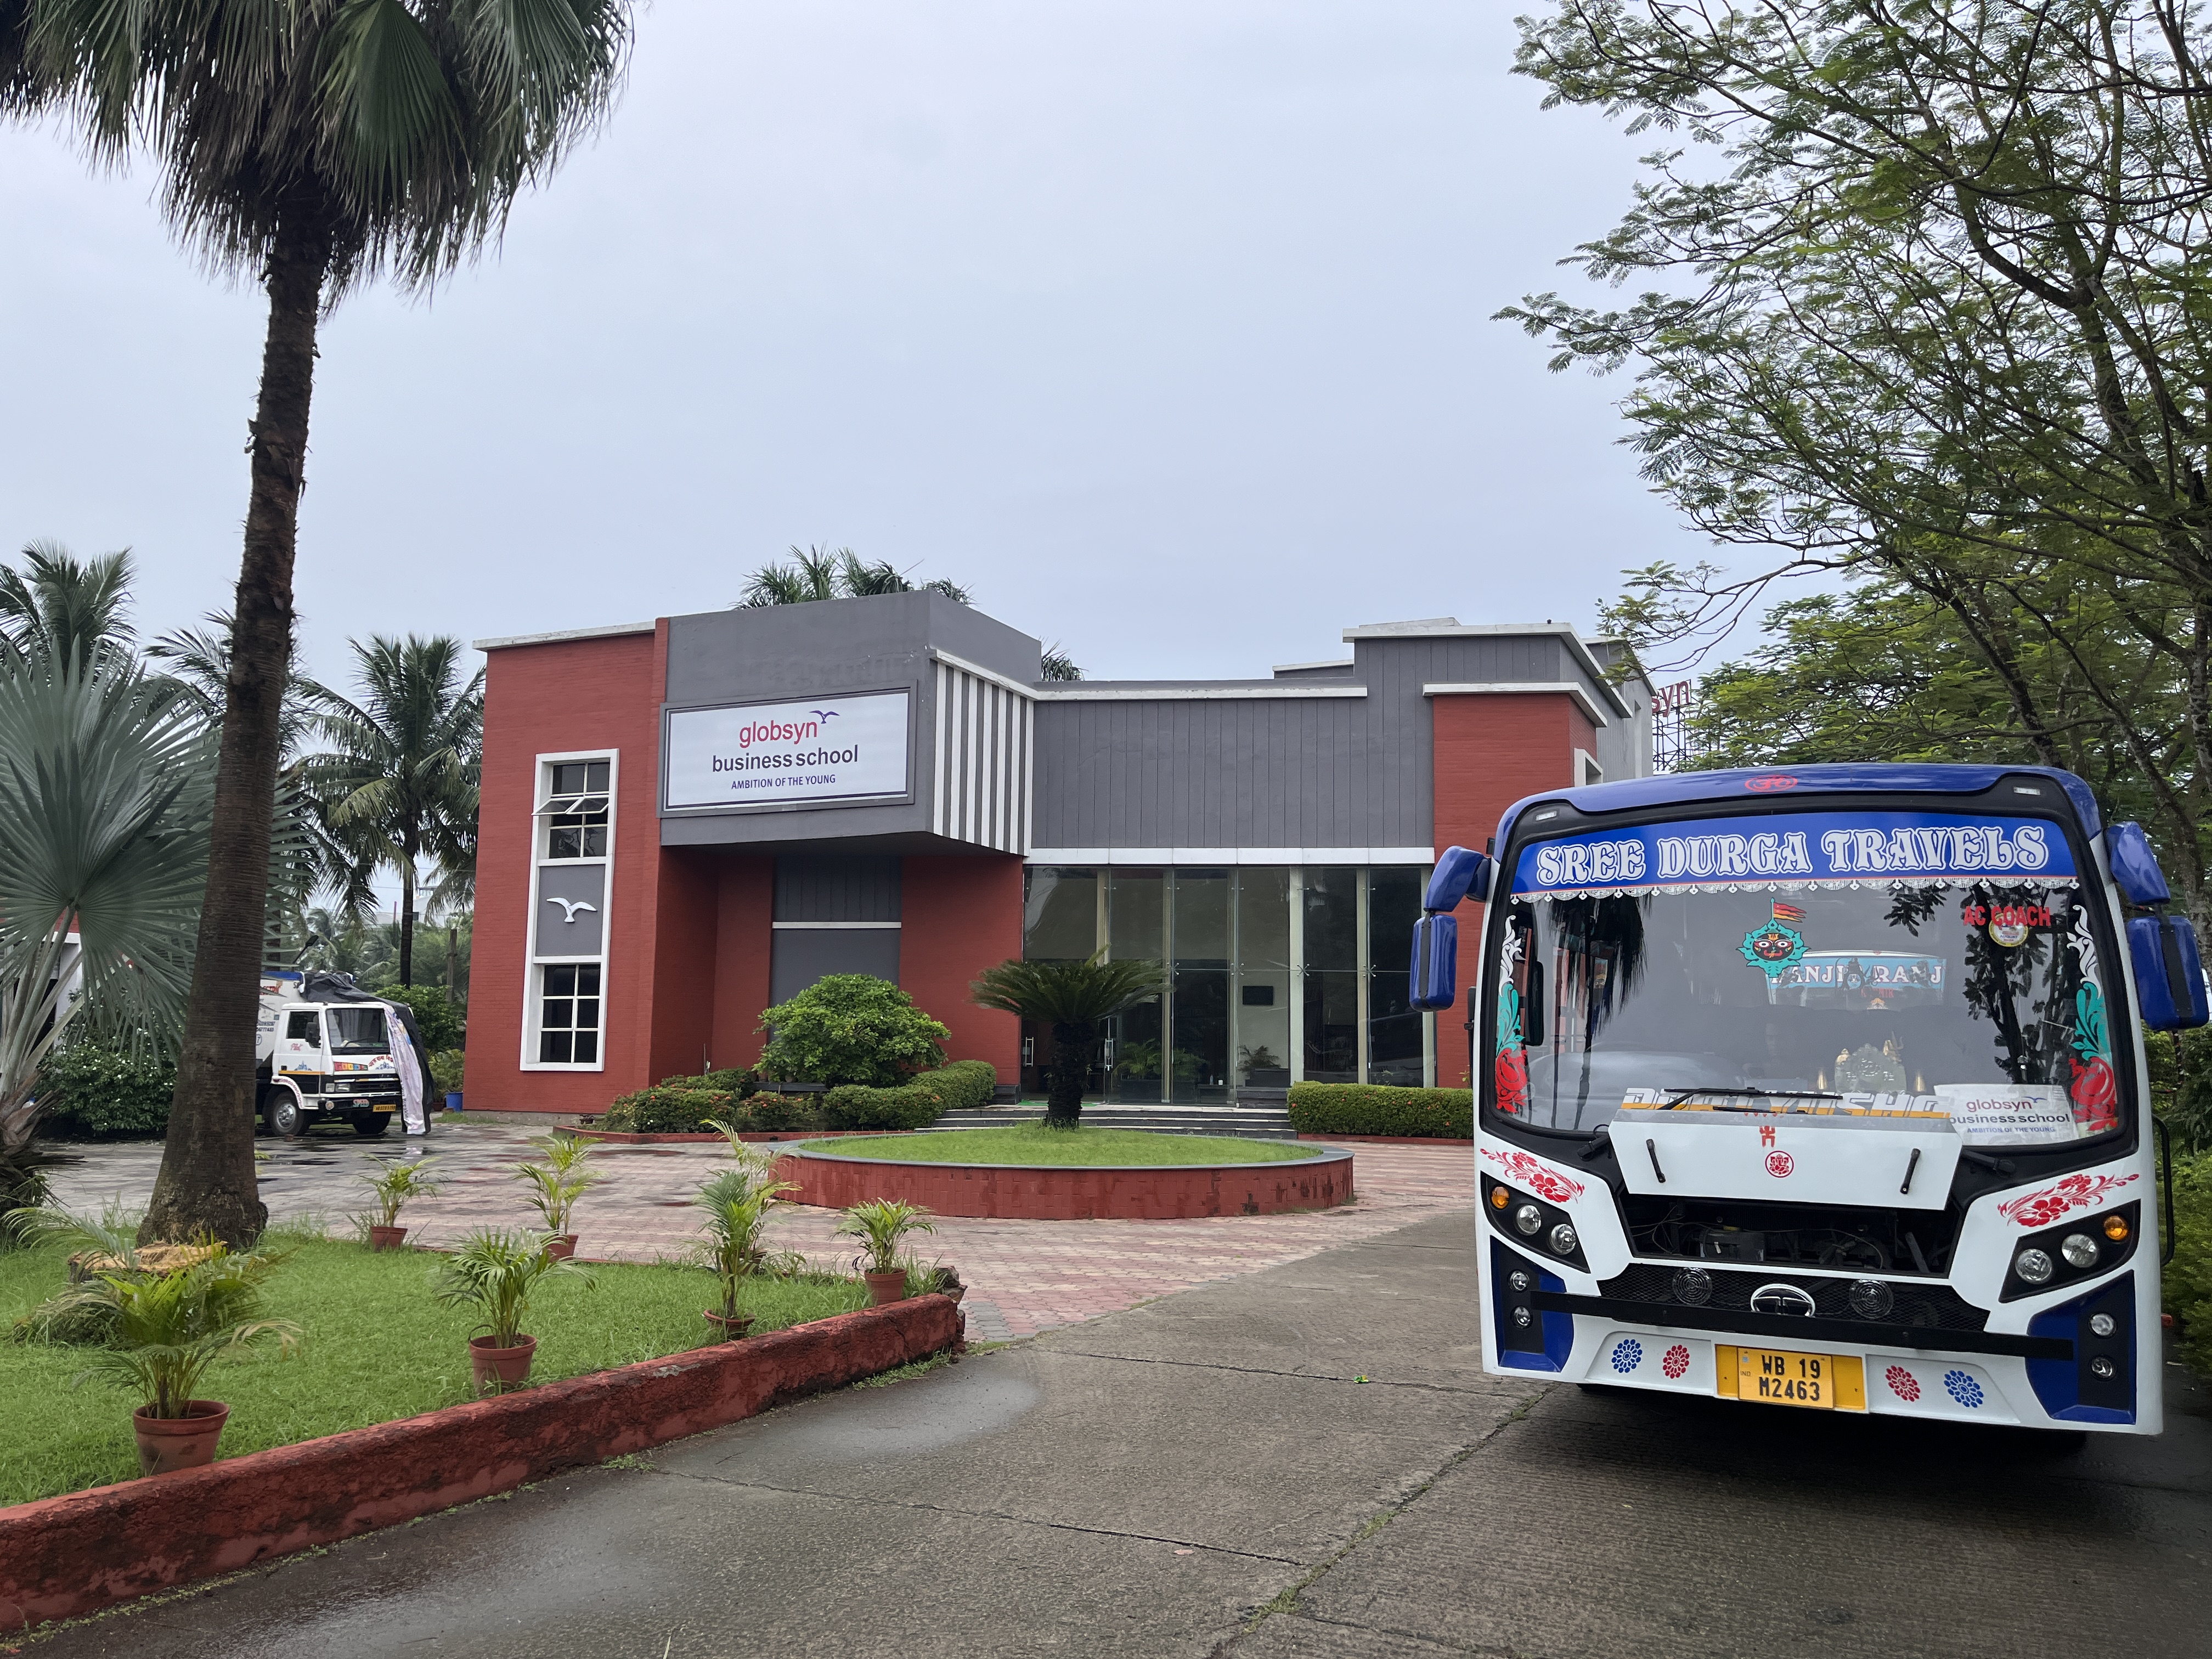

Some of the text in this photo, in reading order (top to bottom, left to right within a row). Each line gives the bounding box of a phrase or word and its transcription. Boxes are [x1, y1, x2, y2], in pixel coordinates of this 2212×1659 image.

[740, 720, 817, 748] globsyn
[713, 744, 858, 772] business school
[731, 774, 836, 789] AMBITION OF THE YOUNG
[1537, 826, 2049, 885] SREE DURGA TRAVELS
[1963, 905, 2051, 927] AC COACH
[1966, 1099, 2032, 1112] globsyn
[2019, 1114, 2070, 1123] school
[1762, 1355, 1820, 1379] WB 19
[1759, 1376, 1820, 1401] M2463
